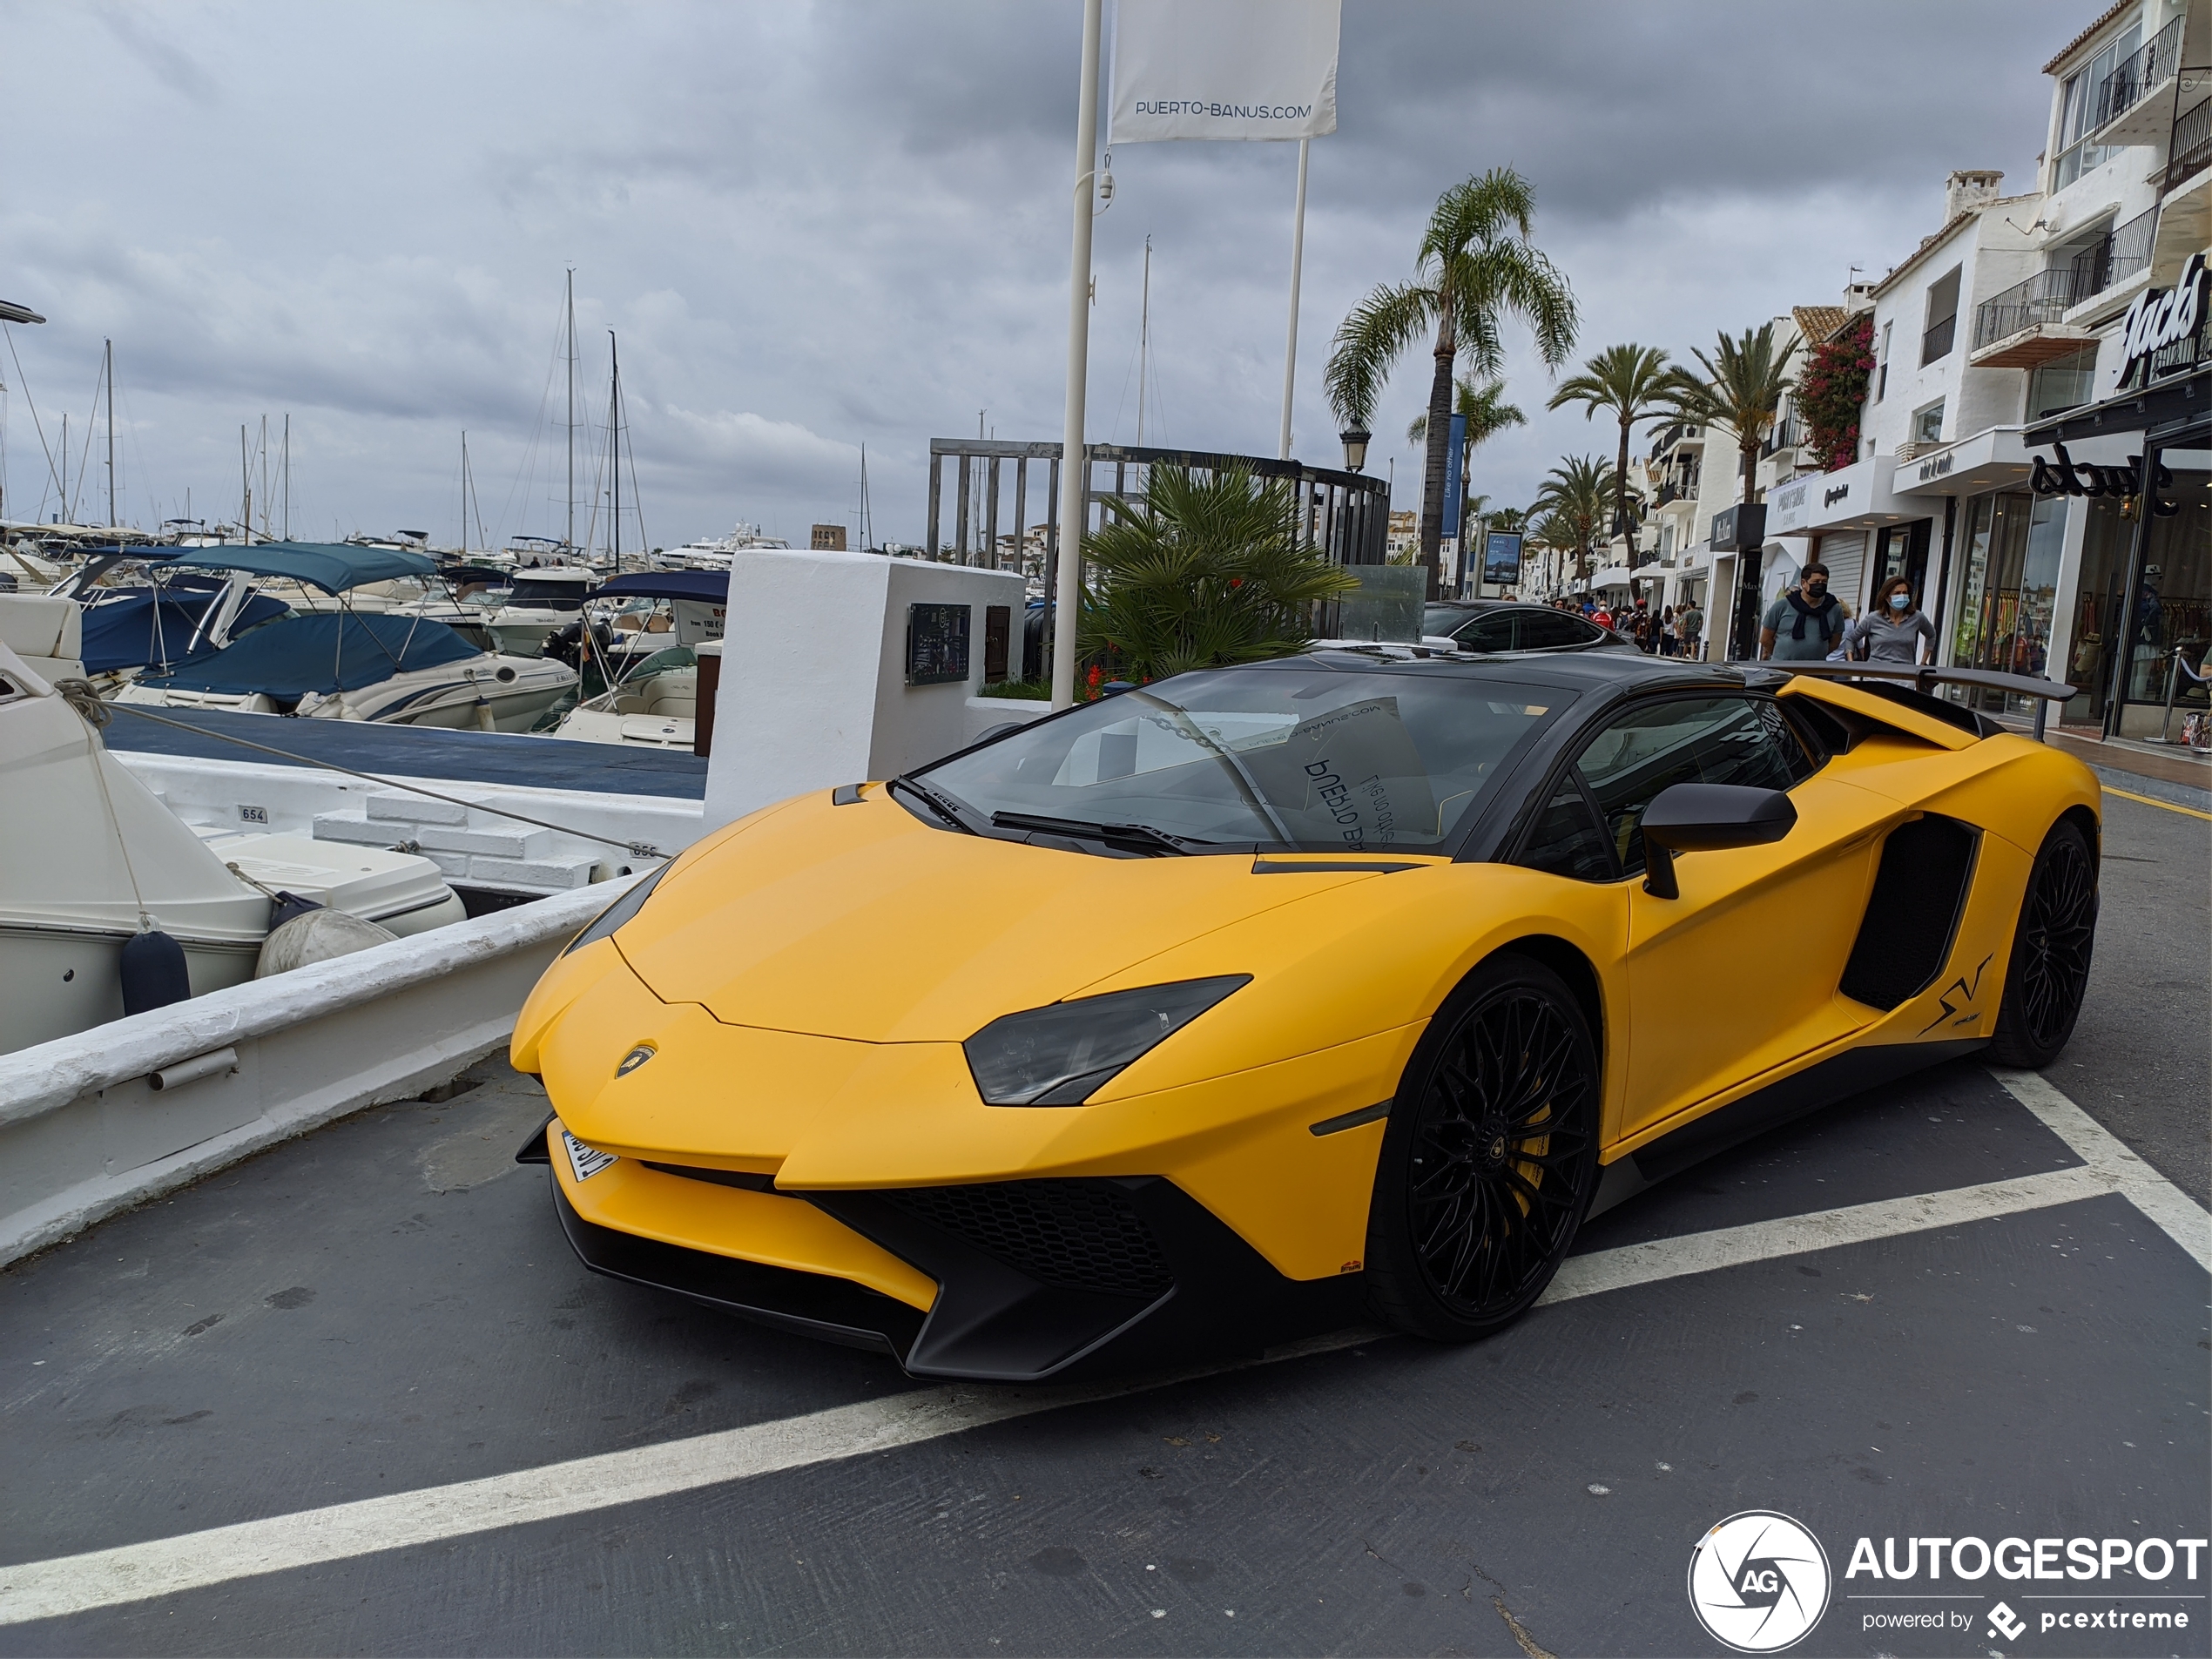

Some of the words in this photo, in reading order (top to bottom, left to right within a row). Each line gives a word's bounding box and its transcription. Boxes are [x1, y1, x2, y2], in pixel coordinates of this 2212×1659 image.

[1136, 101, 1312, 119] PUERTO-BANUS.COM
[2109, 253, 2203, 389] Jacks
[1447, 469, 1453, 481] no
[243, 808, 263, 821] 654
